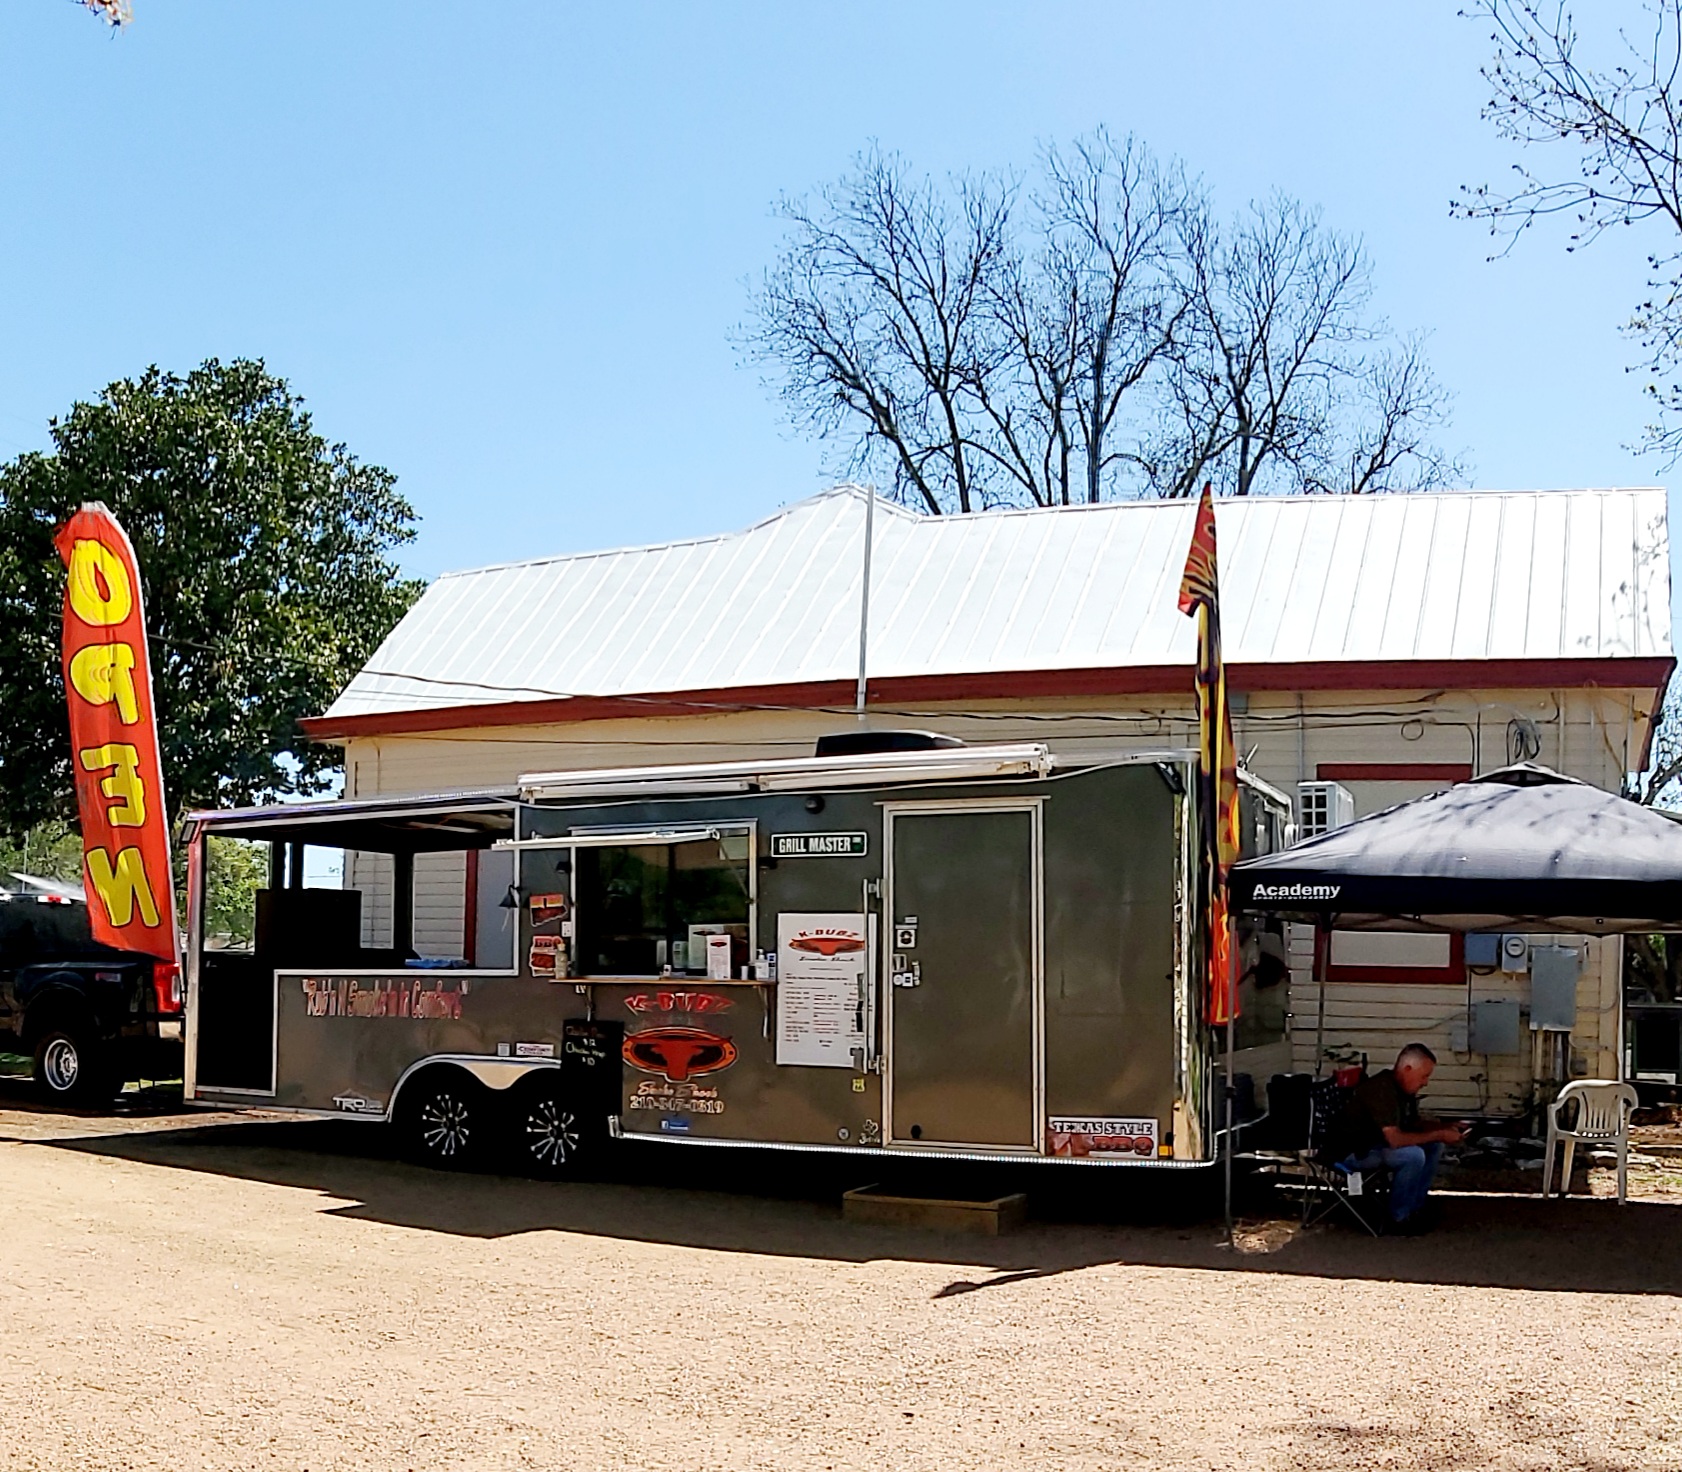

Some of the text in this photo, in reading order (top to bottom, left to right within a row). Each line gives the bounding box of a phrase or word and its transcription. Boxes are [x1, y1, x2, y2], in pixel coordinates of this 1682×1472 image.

[779, 836, 851, 853] GRILL MASTER
[1252, 883, 1341, 899] Academy
[1053, 1121, 1152, 1135] TEXAS STYLE
[1093, 1136, 1153, 1156] BBQ
